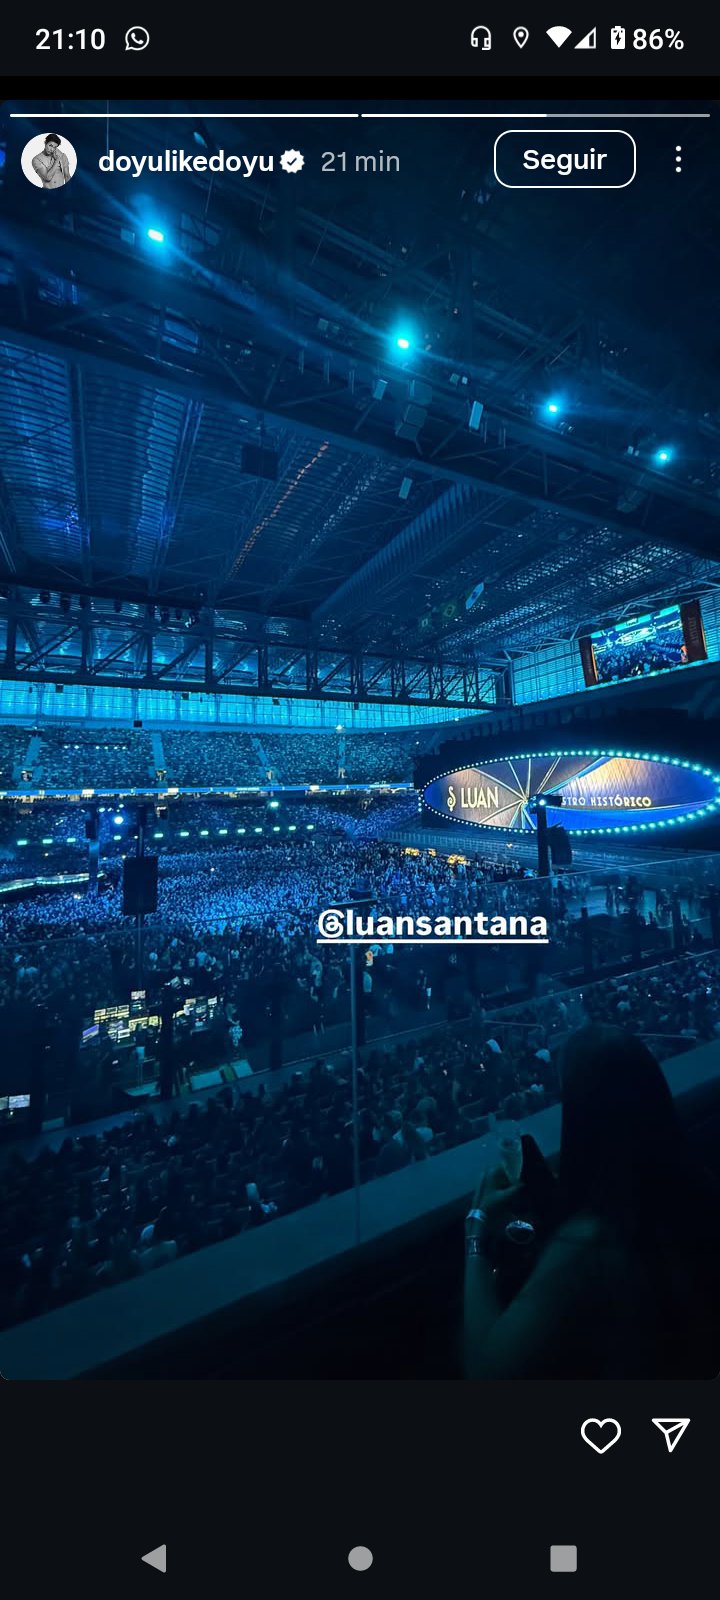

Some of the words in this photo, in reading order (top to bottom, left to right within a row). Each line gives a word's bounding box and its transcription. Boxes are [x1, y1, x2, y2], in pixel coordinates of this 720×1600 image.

[461, 786, 499, 809] LUAN
[561, 796, 586, 806] STRO
[590, 794, 652, 807] HISTÓRICO
